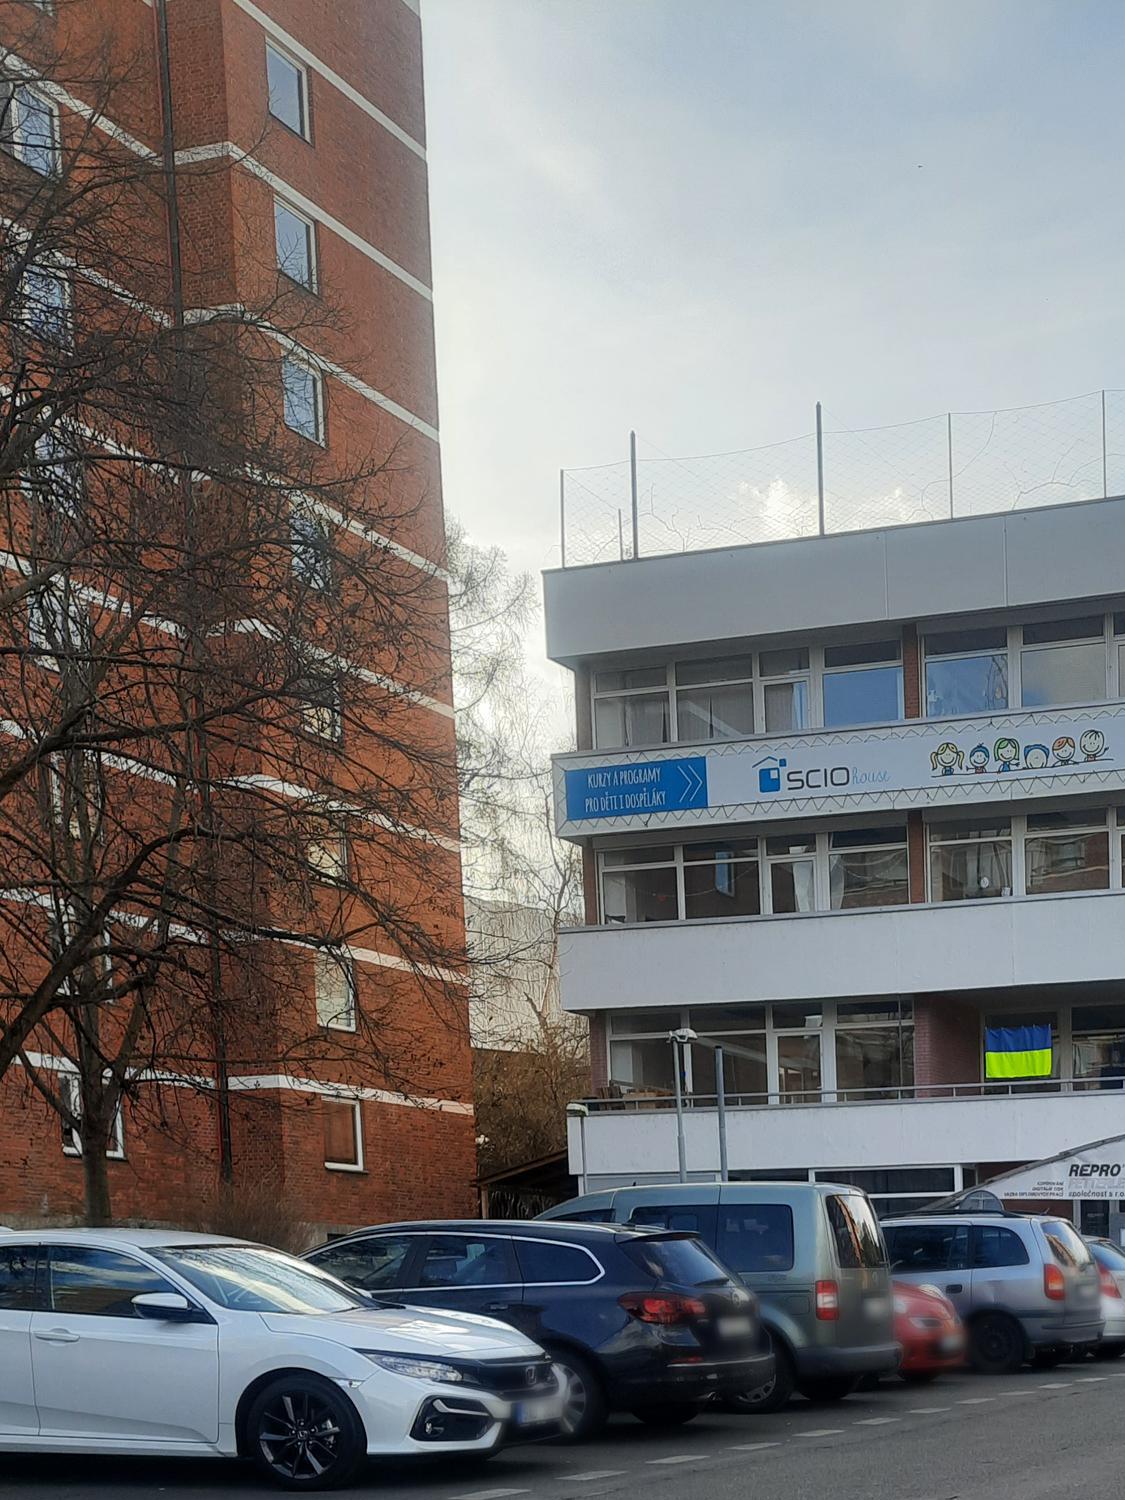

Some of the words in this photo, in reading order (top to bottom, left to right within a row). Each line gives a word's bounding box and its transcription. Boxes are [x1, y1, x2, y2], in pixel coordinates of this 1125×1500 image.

[587, 771, 612, 790] KURZY
[613, 774, 619, 786] A
[620, 767, 661, 786] PROGRAMY
[786, 766, 850, 791] SCIO
[852, 766, 891, 786] house
[585, 796, 599, 813] PRO
[600, 791, 618, 811] DĚTI
[625, 787, 667, 809] DOSPĚLÁKY
